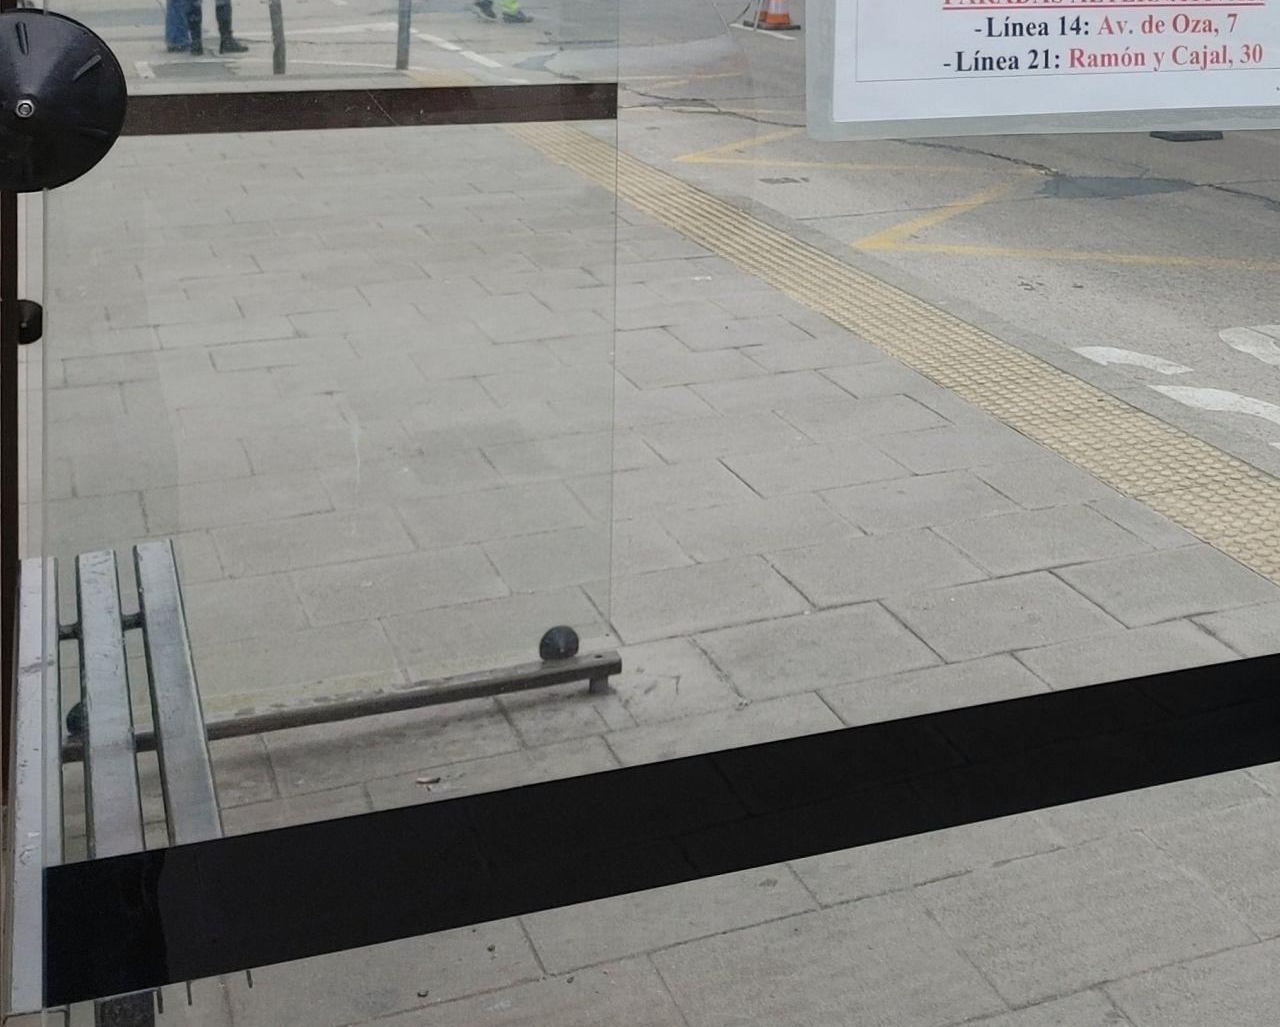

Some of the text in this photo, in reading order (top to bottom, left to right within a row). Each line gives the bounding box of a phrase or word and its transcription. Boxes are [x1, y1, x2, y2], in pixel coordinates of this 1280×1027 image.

[1060, 16, 1088, 35] 14:
[1099, 17, 1132, 34] Av.
[1142, 15, 1164, 33] de
[1173, 14, 1218, 34] Oza,
[1228, 14, 1237, 32] 7
[1028, 49, 1059, 69] 21:
[1071, 47, 1145, 67] Ramón
[1154, 53, 1164, 71] y
[1172, 45, 1232, 70] Cajal,
[1240, 45, 1262, 63] 30
